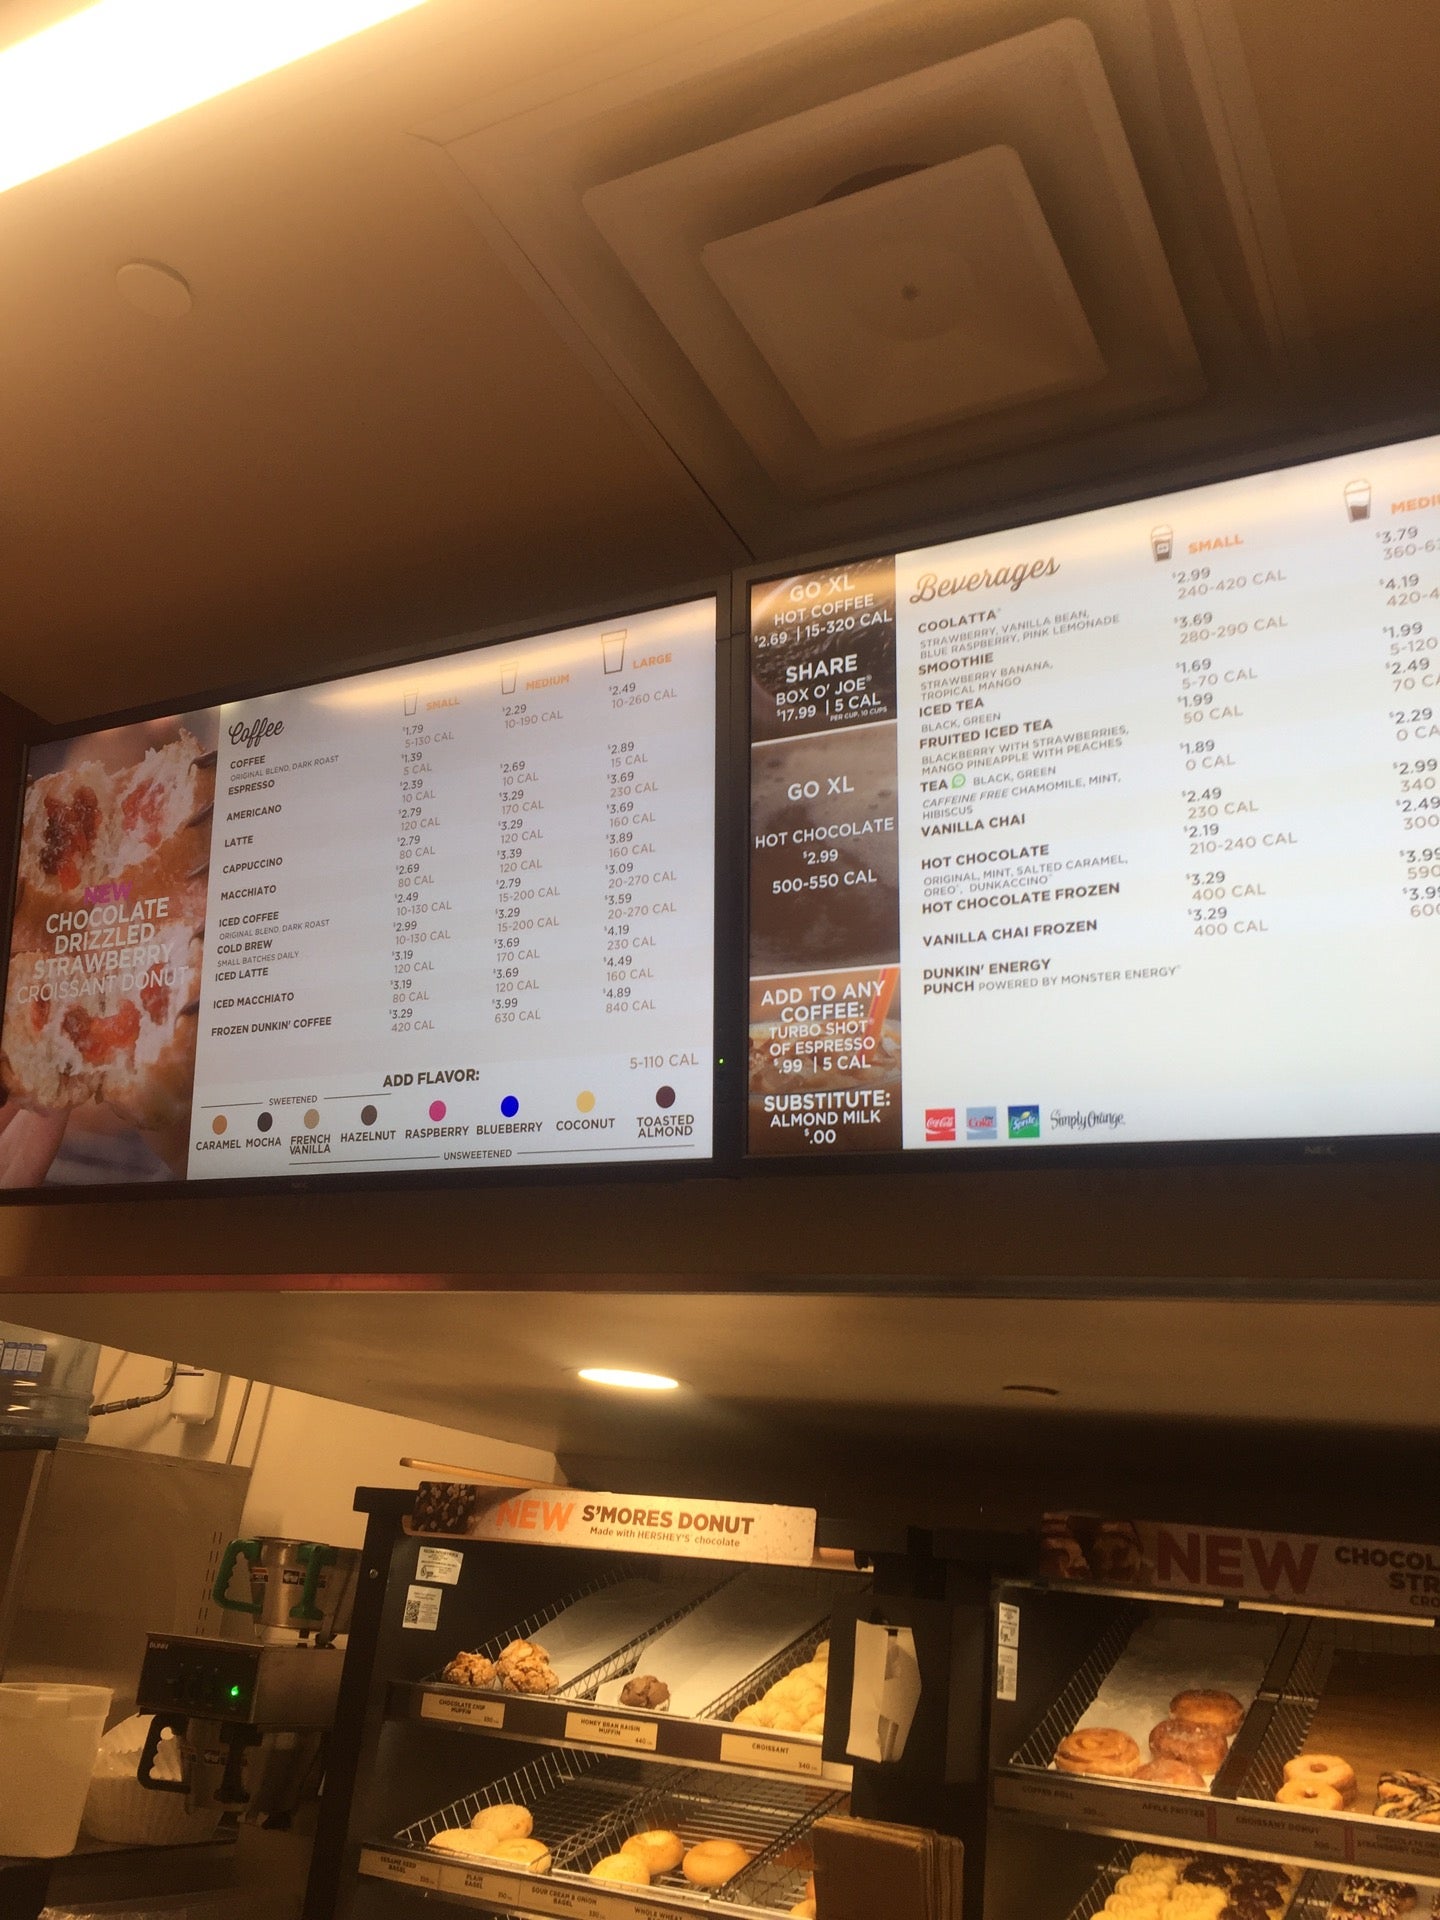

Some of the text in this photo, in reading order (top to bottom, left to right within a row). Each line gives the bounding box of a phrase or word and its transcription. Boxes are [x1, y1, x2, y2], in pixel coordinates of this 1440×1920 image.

[1188, 534, 1244, 554] SMALL
[790, 574, 855, 602] GO XL
[909, 557, 1061, 604] Beverages
[774, 594, 874, 626] HOT COFFEE
[806, 617, 855, 638] 15-320
[860, 610, 892, 627] CAL
[1002, 616, 1051, 633] VANILLA
[920, 645, 949, 659] BLUE
[1023, 627, 1049, 641] PINK
[1053, 614, 1121, 635] LEMONADE
[632, 653, 673, 670] LARGE
[786, 654, 858, 683] SHARE
[918, 652, 994, 675] SMOOTHIE
[526, 674, 570, 690] MEDIUM
[426, 697, 460, 711] SMALL
[776, 688, 809, 706] BOX
[814, 684, 830, 699] O'
[835, 699, 844, 712] 5
[848, 692, 881, 710] CAL
[919, 697, 985, 718] ICED TEA
[228, 717, 284, 748] Coffee
[919, 718, 1053, 749] FRUITED ICED TEA
[230, 755, 266, 769] COFFEE
[228, 779, 275, 795] ESPRESSO
[787, 776, 854, 800] GO XL
[920, 779, 948, 793] TEA
[226, 804, 282, 822] AMERICANO
[755, 817, 894, 849] HOT CHOCOLATE
[921, 813, 1026, 837] VANILLA CHAI
[224, 835, 254, 848] LATTE
[222, 856, 283, 874] CAPPUCCINO
[921, 844, 1050, 870] HOT CHOCOLATE
[772, 869, 877, 894] 500-550 CAL
[82, 881, 133, 905] NEW
[221, 884, 277, 901] MACCHIATO
[922, 882, 1120, 914] HOT CHOCOLATE FROZEN
[45, 896, 170, 935] CHOCOLATE
[219, 911, 279, 928] ICED COFFEE
[54, 924, 156, 955] DRIZZLED
[923, 919, 1098, 947] VANILLA CHAI FROZEN
[217, 940, 273, 954] COLD BREW
[32, 944, 175, 980] STRAWBERRY
[923, 958, 1051, 980] DUNKIN' ENERGY
[16, 965, 190, 1004] CROISSANT DONUT
[215, 967, 269, 982] ICED LATTE
[923, 981, 975, 995] PUNCH
[978, 978, 1038, 992] POWERED
[1042, 975, 1057, 987] BY
[1061, 971, 1121, 985] MONSTER
[213, 992, 295, 1009] ICED MACCHIATO
[761, 980, 886, 1006] ADD TO ANY
[781, 1002, 864, 1023] COFFEE:
[211, 1017, 332, 1036] FROZEN DUNKIN' COFFEE
[769, 1023, 821, 1039] TURBO
[770, 1036, 876, 1056] OF ESPRESSO
[630, 1052, 699, 1070] 5-110 CAL
[823, 1056, 832, 1071] 5
[837, 1055, 871, 1070] CAL
[383, 1067, 480, 1088] ADD FLAVOR:
[269, 1095, 318, 1106] SWEETENED
[764, 1090, 891, 1112] SUBSTITUTE:
[476, 1121, 543, 1135] BLUEBERRY
[556, 1118, 615, 1132] COCONUT
[637, 1115, 695, 1129] TOASTED
[770, 1109, 881, 1128] ALMOND MILK
[245, 1137, 282, 1148] MOCHA
[290, 1134, 331, 1145] FRENCH
[340, 1130, 396, 1143] HAZELNUT
[405, 1126, 469, 1140] RASPBERRY
[638, 1125, 694, 1140] ALMOND
[196, 1139, 242, 1151] CARAMEL
[290, 1143, 331, 1155] VANILLA
[443, 1148, 512, 1161] UNSWEETENED
[496, 1499, 577, 1533] NEW
[678, 1512, 754, 1536] DONUT
[589, 1526, 614, 1537] Made
[616, 1528, 636, 1539] with
[694, 1535, 741, 1548] chocolate
[1156, 1530, 1319, 1594] NEW
[580, 1719, 640, 1732] HONEY BRAN RAISIN
[599, 1728, 620, 1736] MUFFIN
[752, 1742, 789, 1754] CROISSANT
